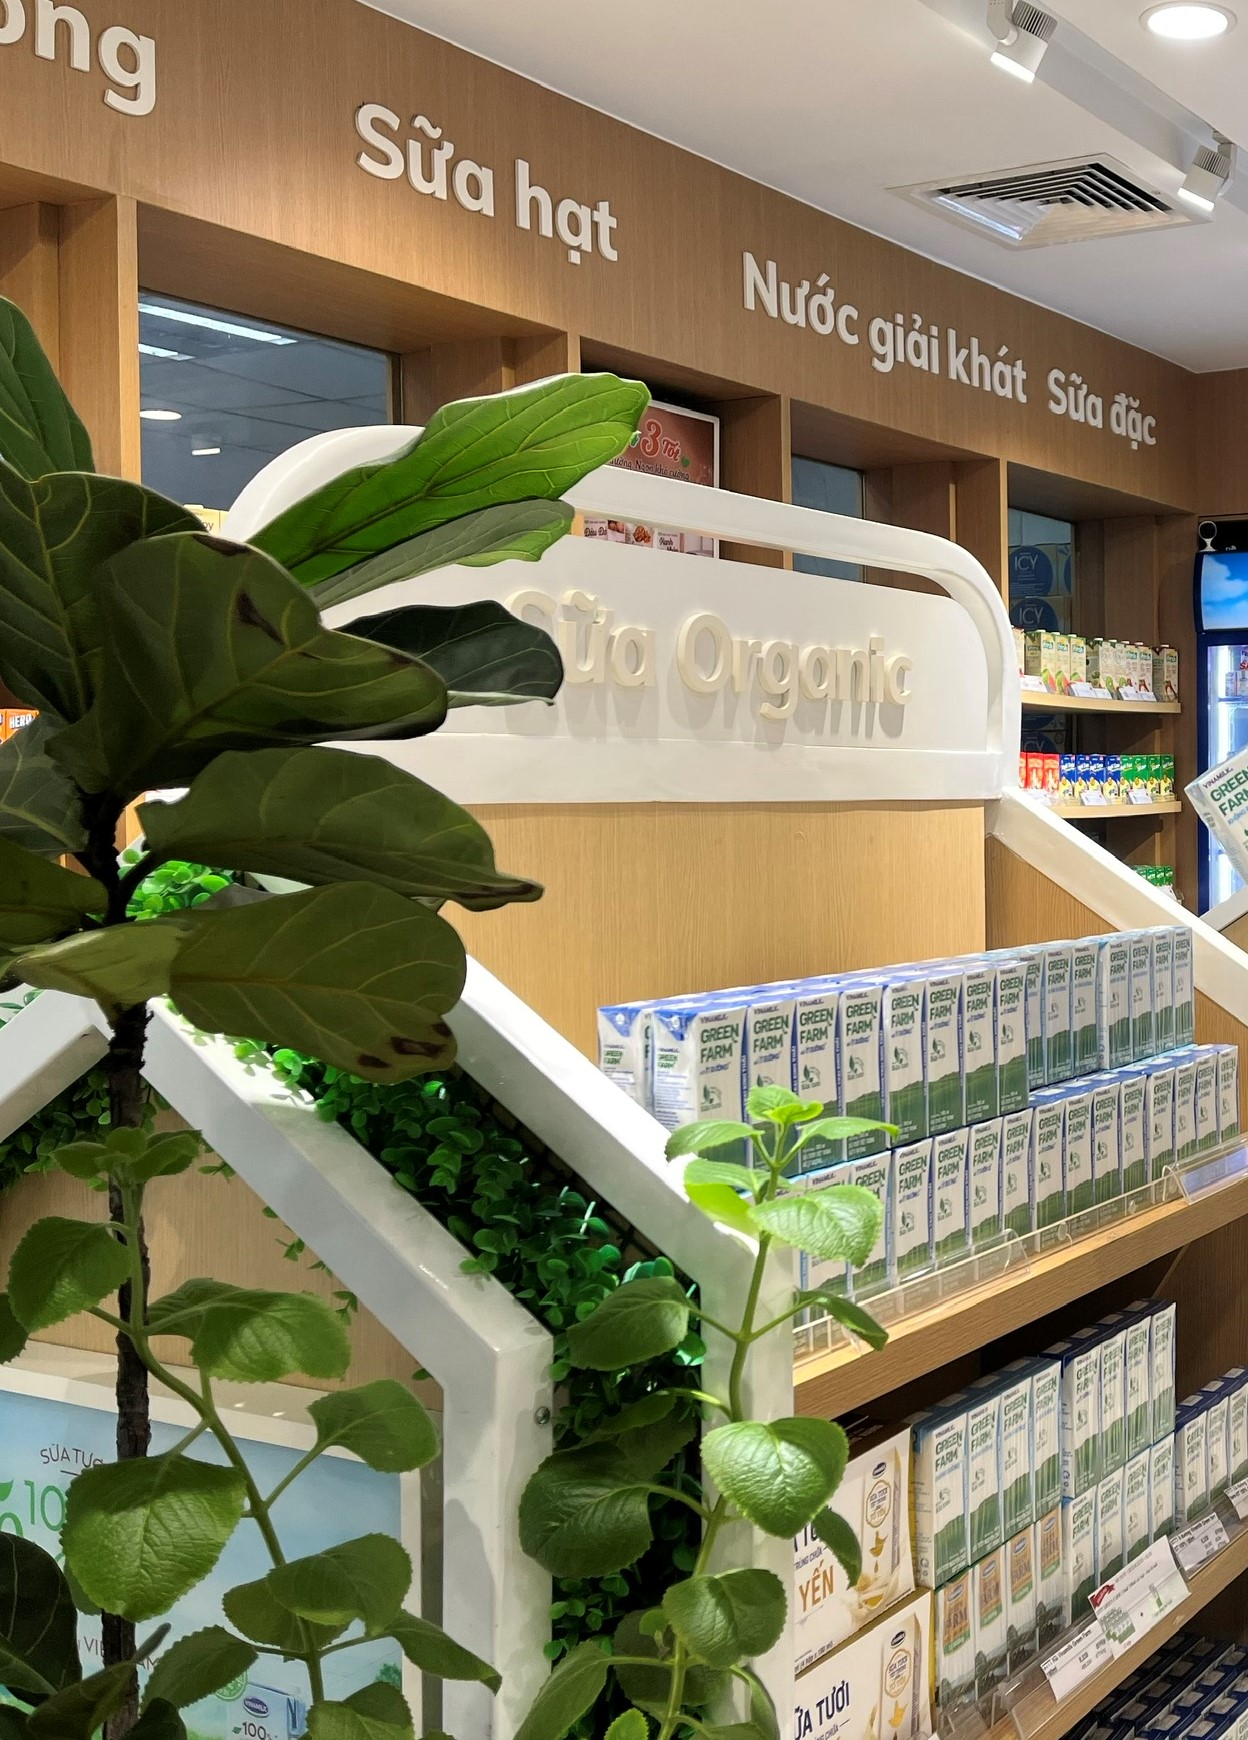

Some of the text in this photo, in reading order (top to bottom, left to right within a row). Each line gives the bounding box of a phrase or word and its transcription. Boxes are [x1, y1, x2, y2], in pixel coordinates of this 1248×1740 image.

[355, 103, 618, 264] Sữa hạt
[743, 251, 1027, 403] Nước giải khát
[1047, 369, 1157, 450] Sữa đặc
[640, 419, 662, 457] 3
[1014, 555, 1038, 571] ICY
[1019, 607, 1043, 624] ICY
[676, 613, 913, 720] Organic
[1202, 766, 1234, 789] VINAMILK
[1133, 945, 1149, 958] GREEN
[1156, 941, 1171, 952] GREEN
[1176, 936, 1190, 949] GREEN
[1048, 957, 1069, 972] GREEN
[1075, 954, 1095, 968] GREEN
[1110, 950, 1128, 962] GREEN
[1133, 959, 1147, 971] FARM
[1156, 954, 1169, 965] FARM
[1175, 951, 1188, 961] FARM
[1048, 973, 1065, 985] FARM
[1075, 968, 1092, 980] FARM
[1110, 964, 1125, 976] FARM
[967, 980, 992, 998] GREEN
[1000, 975, 1023, 992] GREEN
[892, 993, 919, 1011] GREEN
[930, 987, 957, 1004] GREEN
[1000, 992, 1019, 1006] FARM
[846, 1001, 878, 1018] GREEN
[930, 1004, 952, 1021] FARM
[966, 997, 988, 1013] FARM
[753, 1015, 789, 1035] GREEN
[800, 1007, 834, 1026] GREEN
[891, 1011, 915, 1029] FARM
[700, 1023, 739, 1044] GREEN
[800, 1026, 828, 1044] FARM
[846, 1019, 873, 1036] FARM
[753, 1035, 784, 1053] FARM
[700, 1046, 733, 1064] FARM
[1039, 1113, 1061, 1129] GREEN
[1069, 1105, 1089, 1121] GREEN
[1007, 1122, 1028, 1140] GREEN
[1068, 1120, 1086, 1135] FARM
[974, 1132, 998, 1151] GREEN
[1039, 1130, 1057, 1146] FARM
[938, 1144, 965, 1163] GREEN
[1006, 1140, 1024, 1156] FARM
[899, 1155, 927, 1174] GREEN
[973, 1151, 994, 1166] FARM
[856, 1168, 885, 1187] GREEN
[938, 1162, 959, 1179] FARM
[899, 1174, 923, 1193] FARM
[1036, 1375, 1056, 1400] GREEN
[1004, 1392, 1027, 1417] GREEN
[1036, 1394, 1054, 1414] FARM
[971, 1410, 995, 1436] GREEN
[1004, 1410, 1024, 1432] FARM
[935, 1430, 963, 1455] GREEN
[971, 1430, 992, 1453] FARM
[935, 1448, 959, 1472] FARM
[799, 1559, 834, 1612] YẾN
[816, 1680, 850, 1726] TƯƠI
